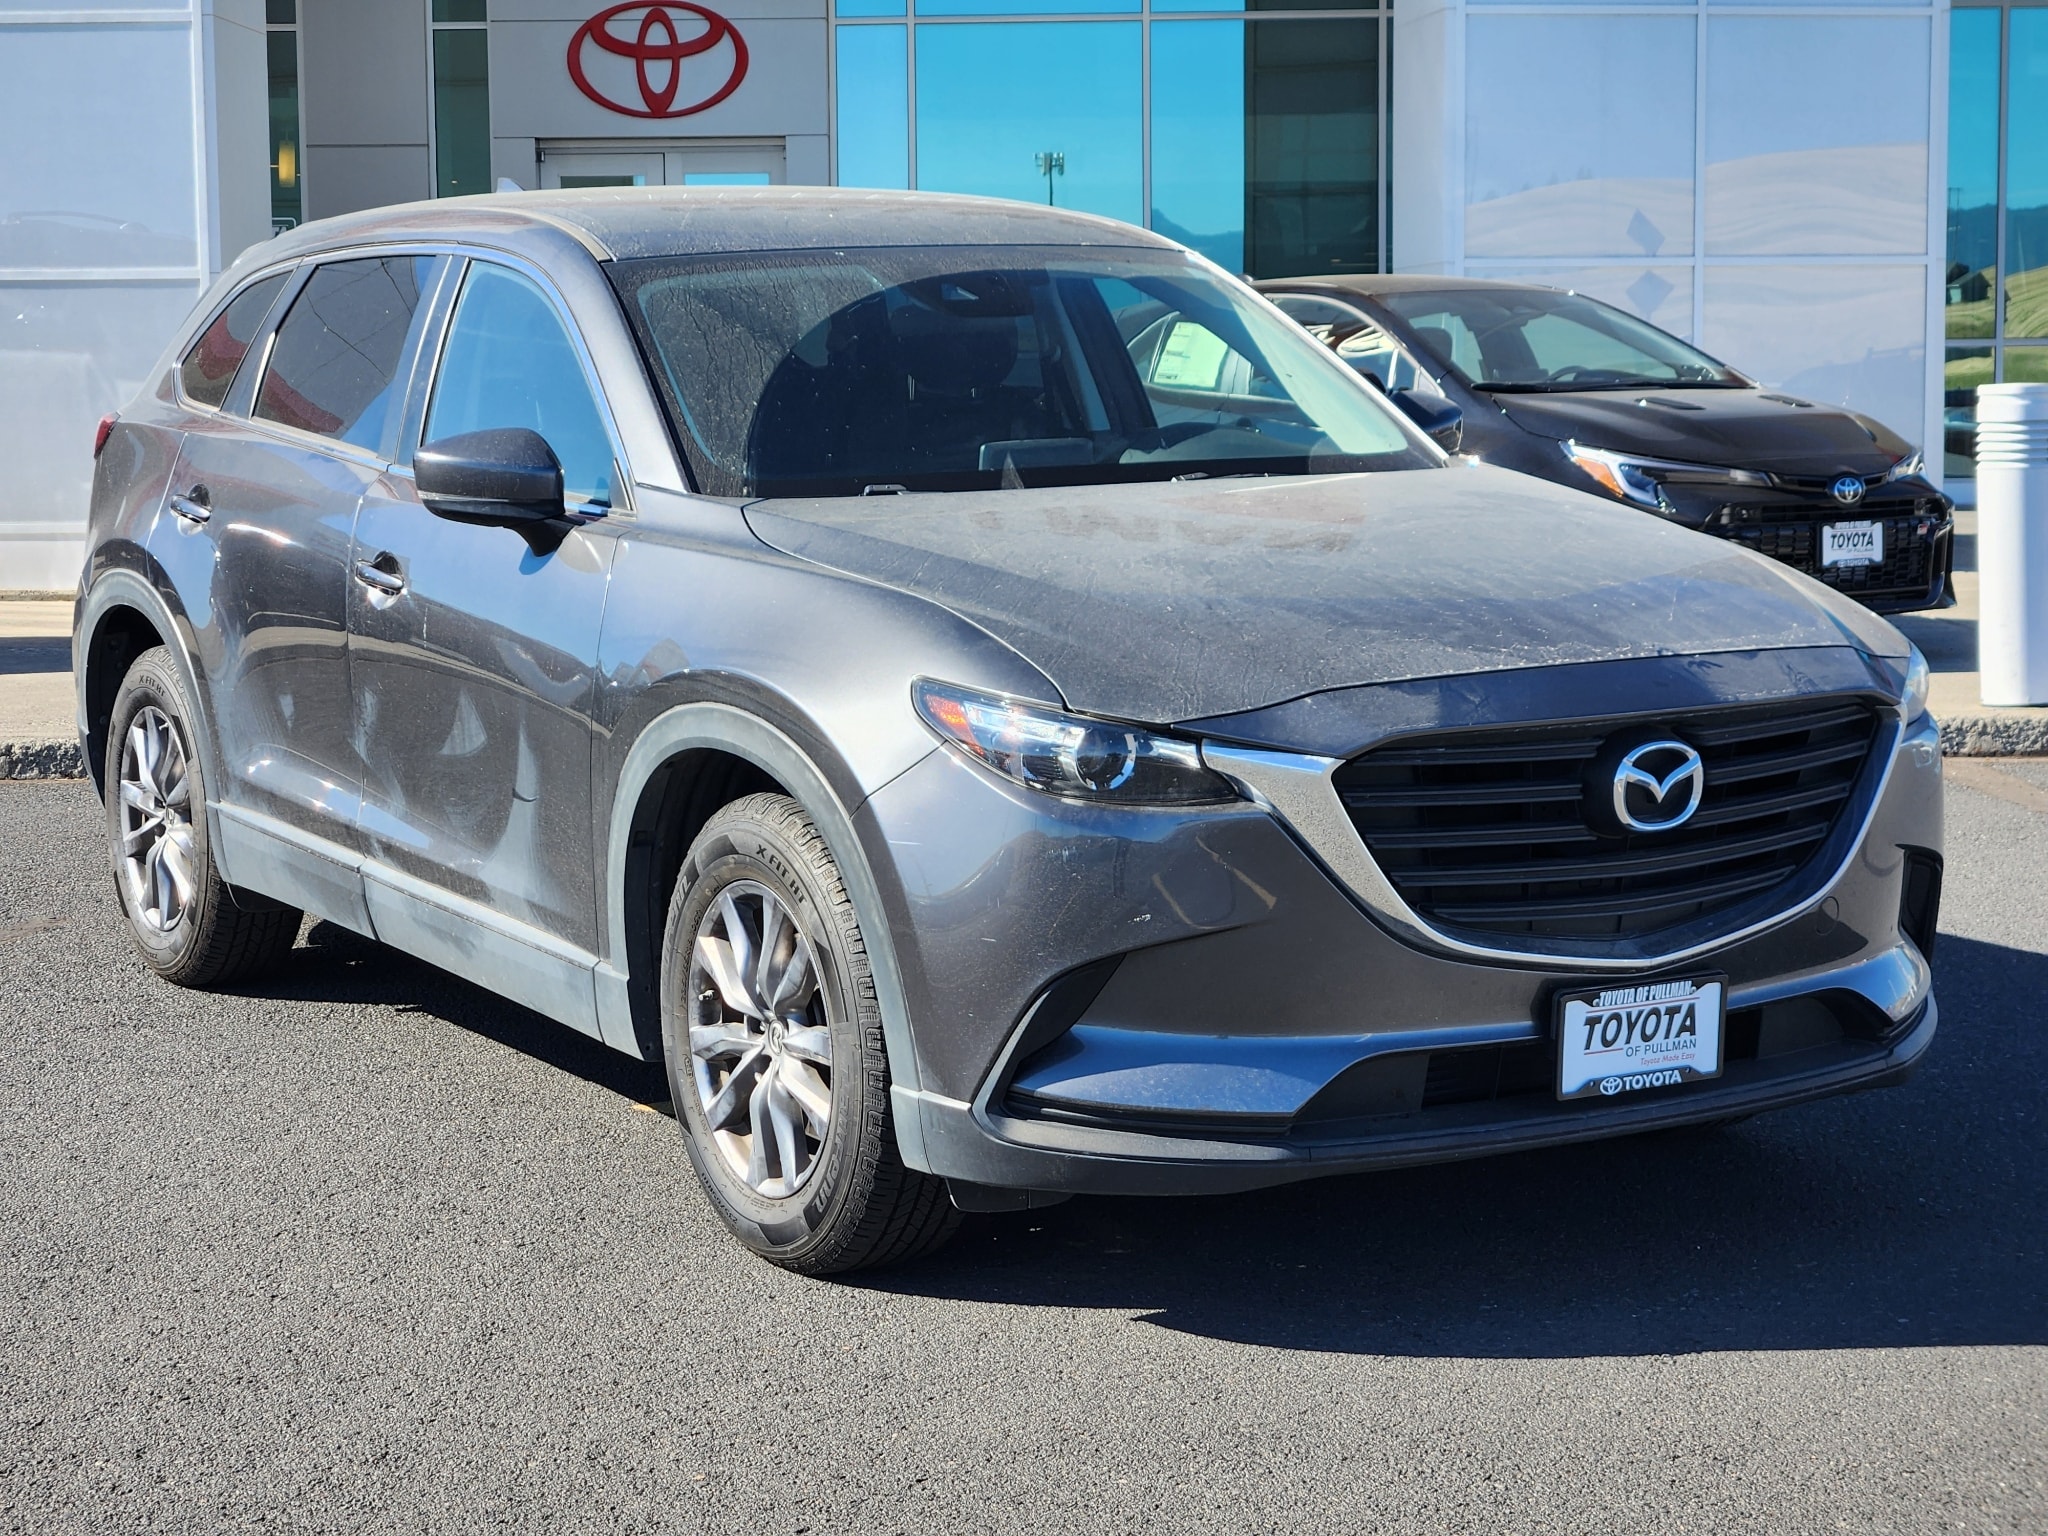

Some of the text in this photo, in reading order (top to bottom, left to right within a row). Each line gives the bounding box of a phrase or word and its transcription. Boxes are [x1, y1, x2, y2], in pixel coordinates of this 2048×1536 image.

[1830, 532, 1874, 549] TOYOTA
[756, 844, 807, 904] X FIT HT
[1600, 980, 1693, 1007] TOYOTA OF PULLMAN
[1583, 1003, 1697, 1051] TOYOTA
[1625, 1038, 1697, 1057] OF PULLMAN
[1640, 1052, 1696, 1066] Toyota Made Easy
[1622, 1069, 1682, 1091] TOYOTA
